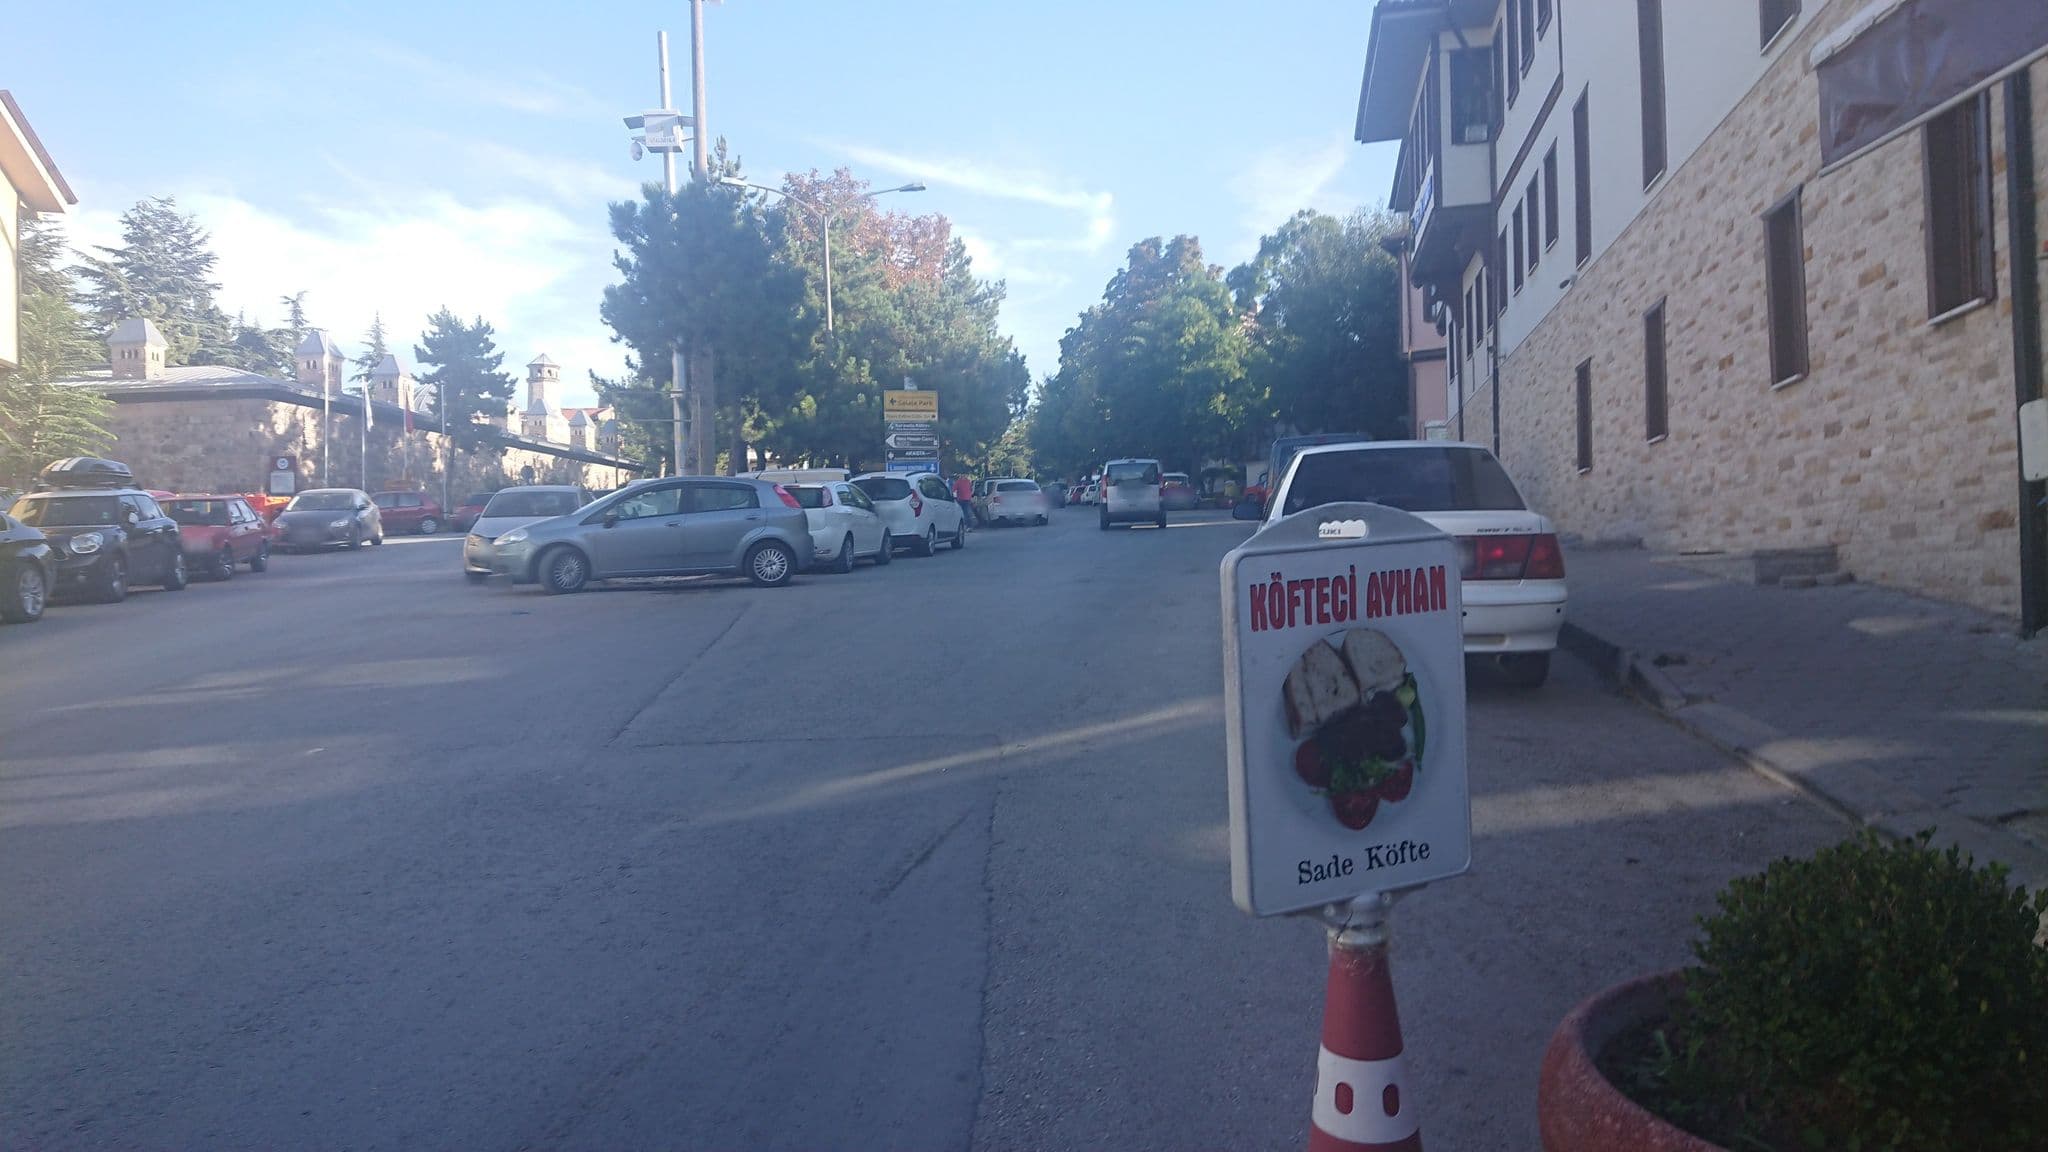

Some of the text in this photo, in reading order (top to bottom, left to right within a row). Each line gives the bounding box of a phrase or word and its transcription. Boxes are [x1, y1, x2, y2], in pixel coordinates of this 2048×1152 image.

[1249, 564, 1447, 632] KÖFTECİ AYHAN
[1298, 840, 1431, 885] Sade Köfte
